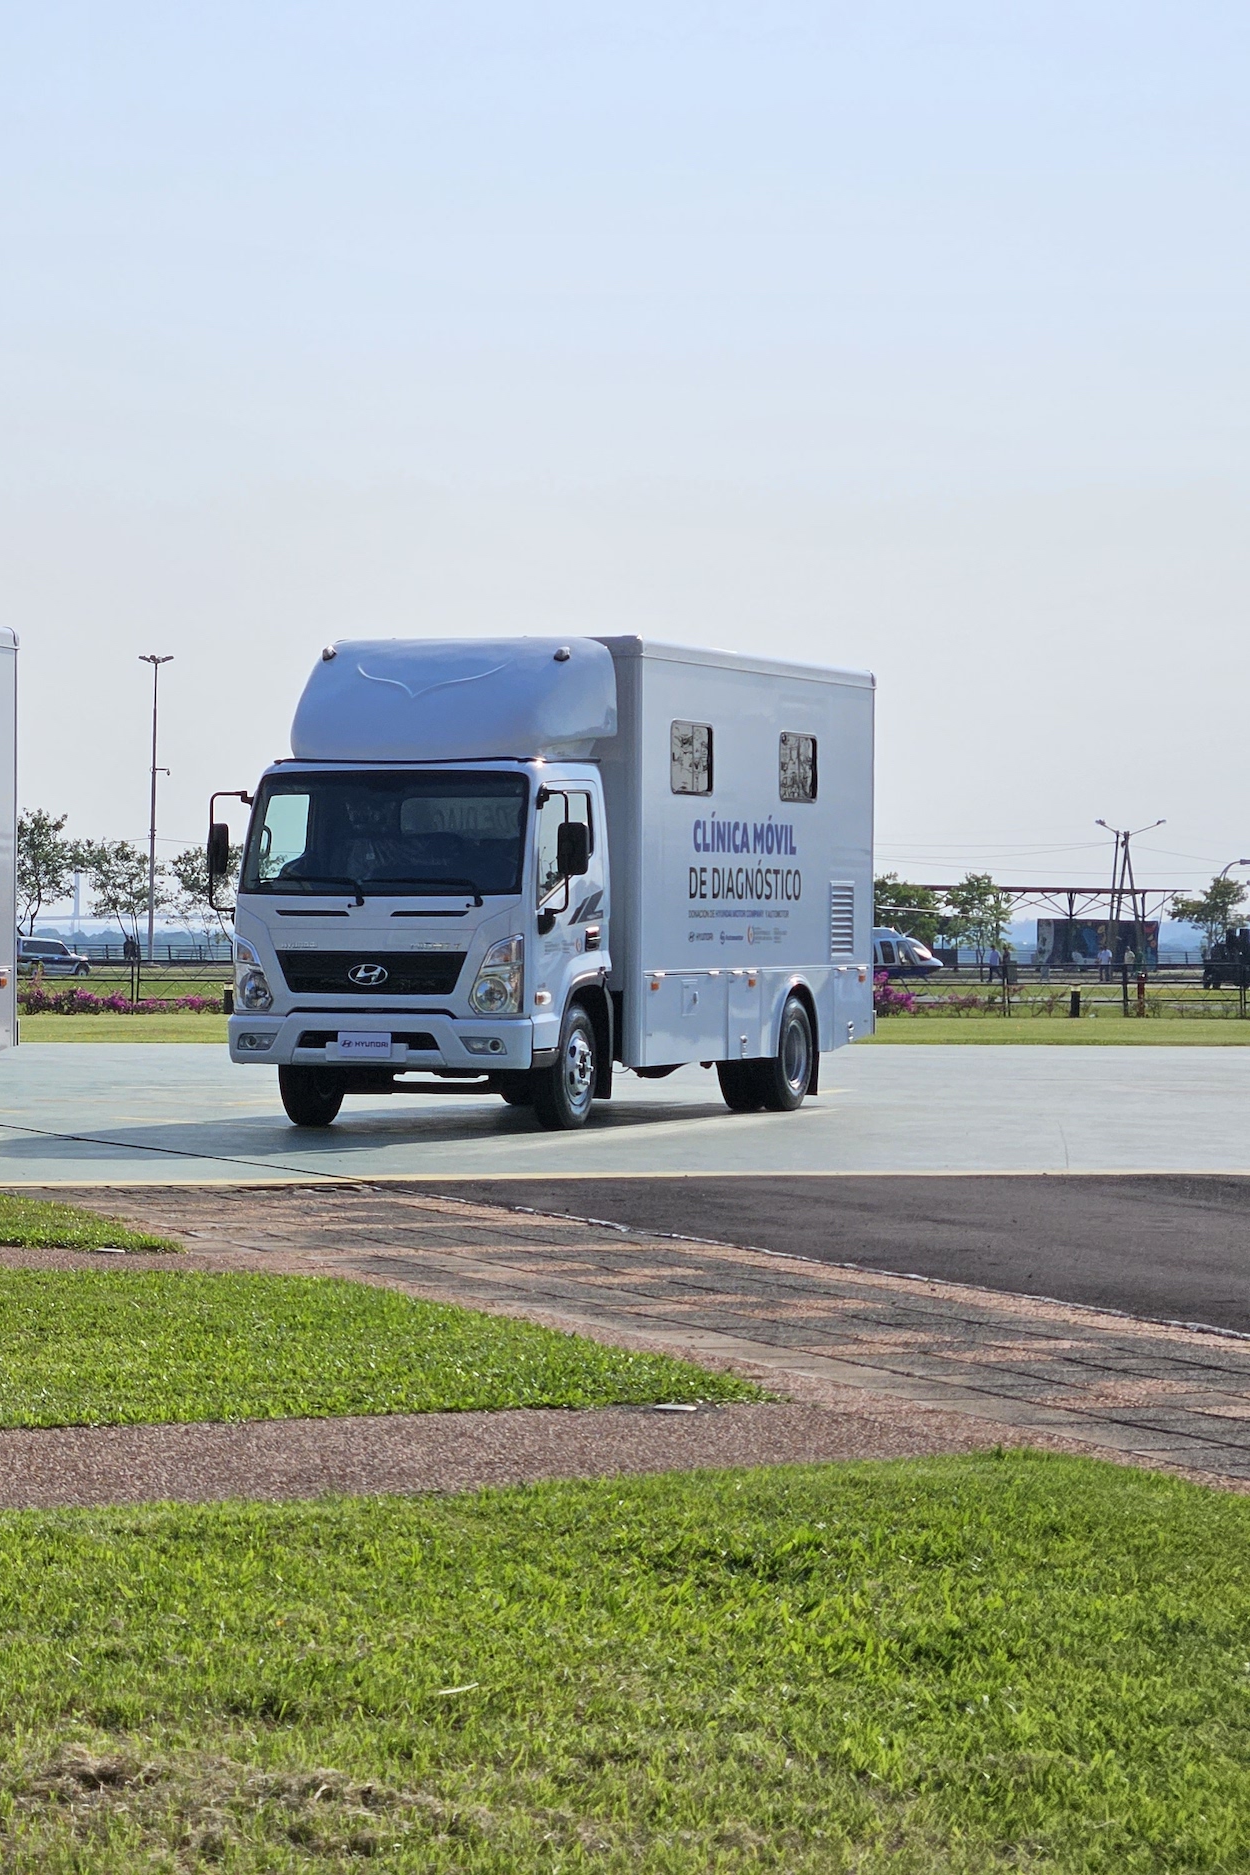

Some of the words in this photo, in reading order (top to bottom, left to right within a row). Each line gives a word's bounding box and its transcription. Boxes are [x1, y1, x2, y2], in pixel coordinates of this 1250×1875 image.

[693, 811, 750, 853] CLÍNICA
[753, 815, 797, 855] MÓVIL
[689, 867, 707, 899] DE
[712, 859, 802, 901] DIAGNÓSTICO
[354, 1041, 389, 1049] HYUNDAI
